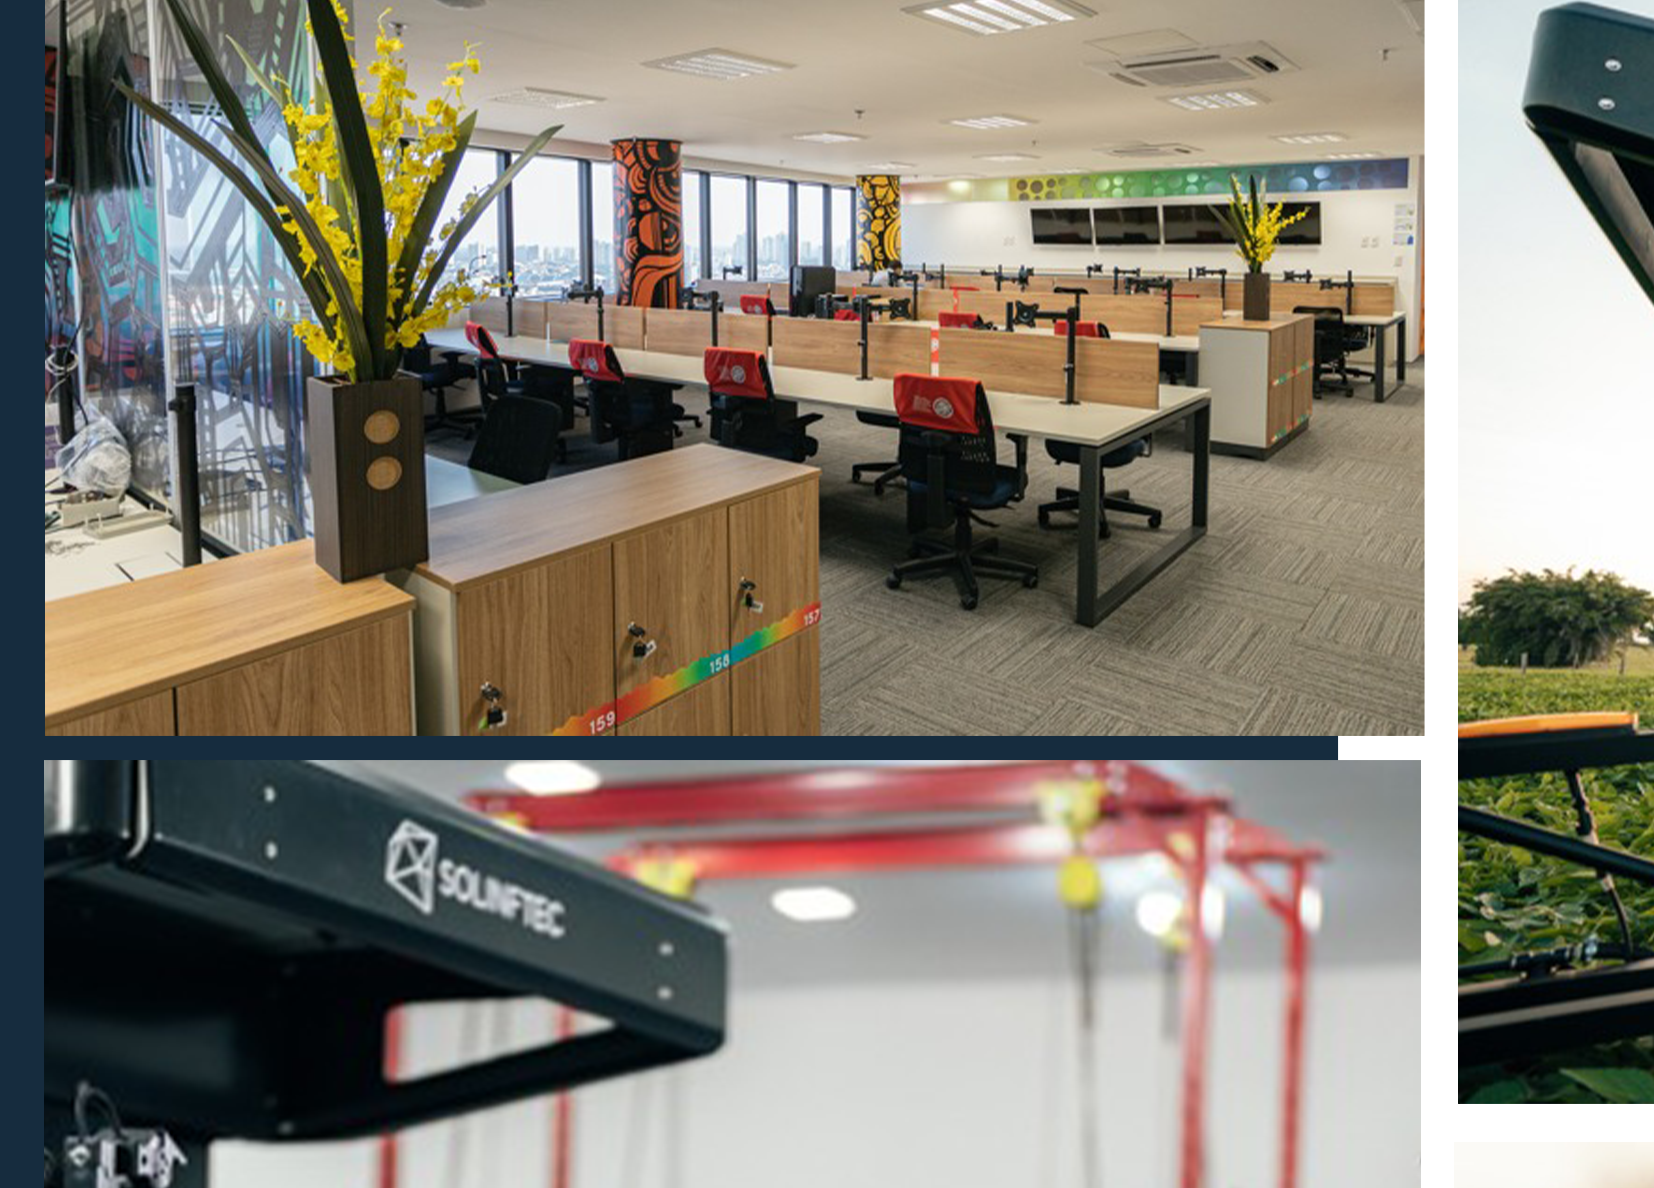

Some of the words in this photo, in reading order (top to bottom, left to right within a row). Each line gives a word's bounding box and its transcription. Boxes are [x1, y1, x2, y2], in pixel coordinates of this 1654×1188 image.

[803, 608, 821, 627] 157
[709, 653, 731, 674] 158
[589, 711, 616, 735] 159
[437, 858, 566, 938] SOLINFTEC
